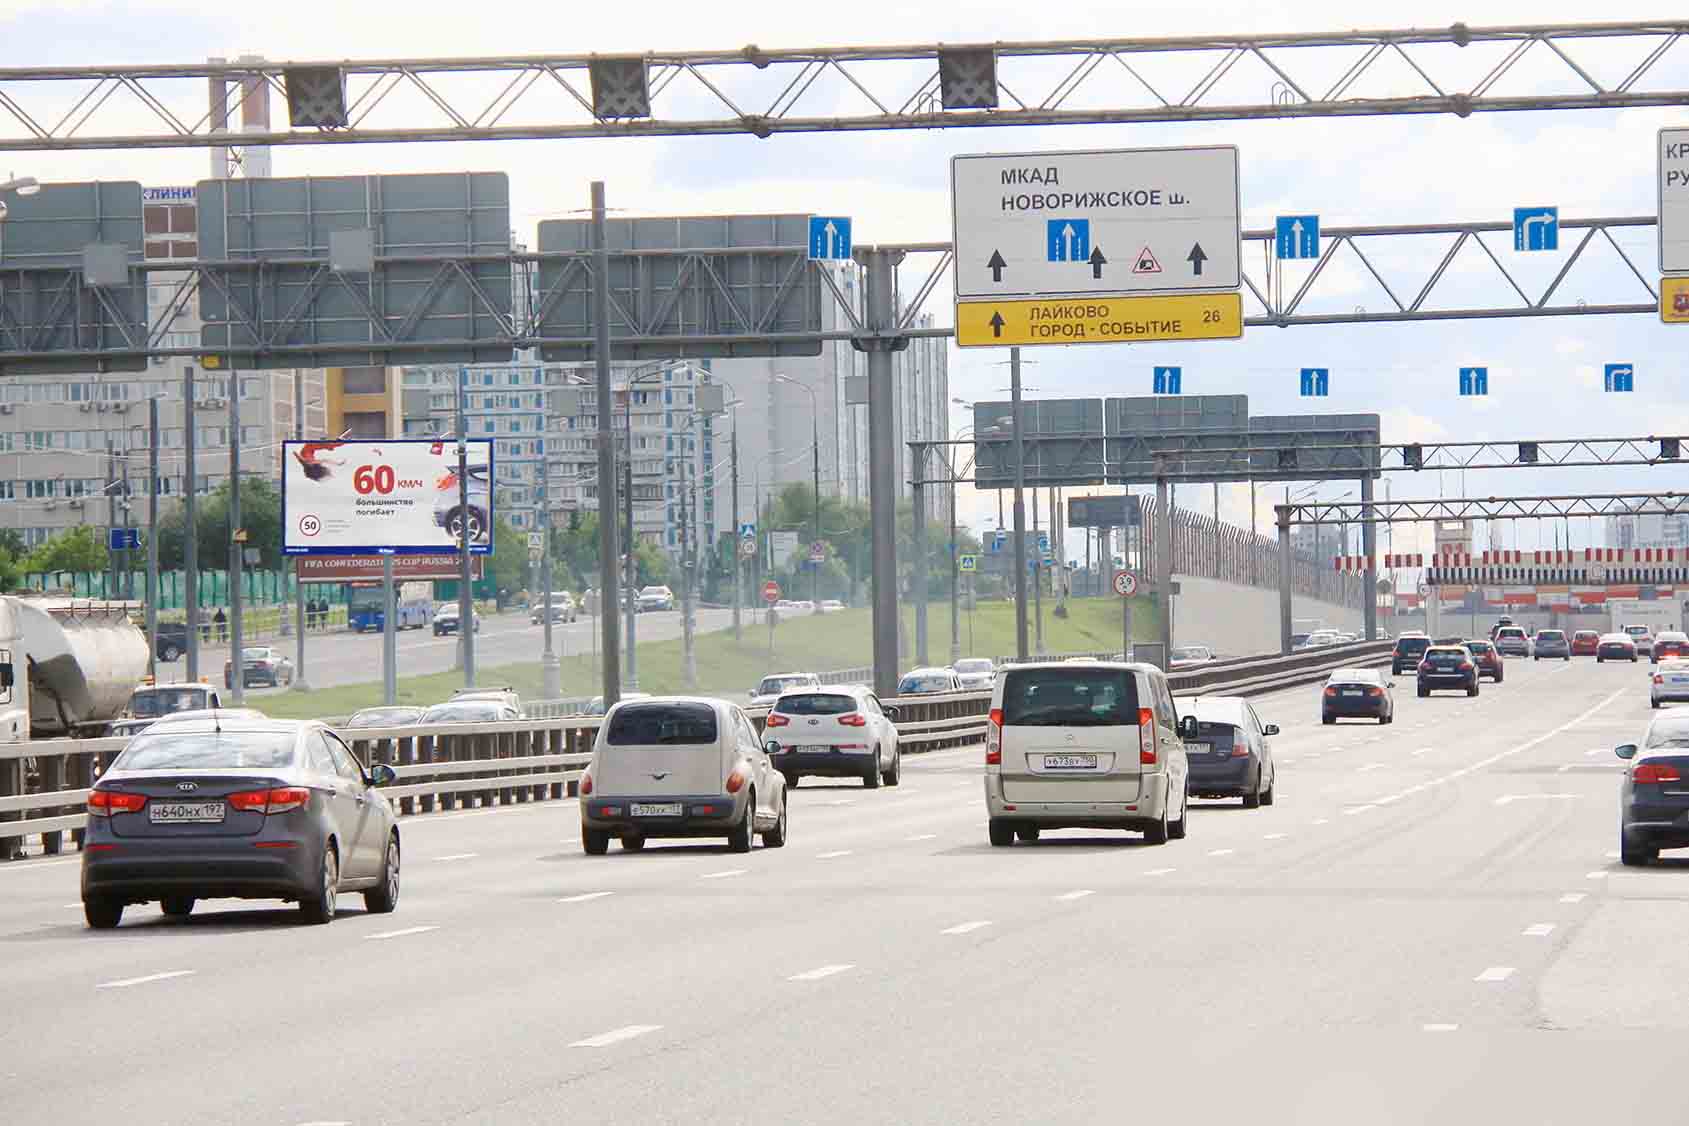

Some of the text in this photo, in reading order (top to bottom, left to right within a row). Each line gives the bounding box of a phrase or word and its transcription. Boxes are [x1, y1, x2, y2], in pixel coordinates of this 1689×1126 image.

[1001, 167, 1059, 186] МКАД
[1001, 190, 1162, 211] НОВОРИЖСКОЕ
[1030, 304, 1110, 320] ЛАЙКОВО
[1202, 310, 1221, 324] 26
[1030, 323, 1085, 338] ГОРОД
[1100, 320, 1182, 336] СОБЫТИЕ
[353, 464, 395, 495] 60
[355, 497, 414, 506] большинство
[355, 508, 395, 516] погибает
[304, 521, 317, 530] 50
